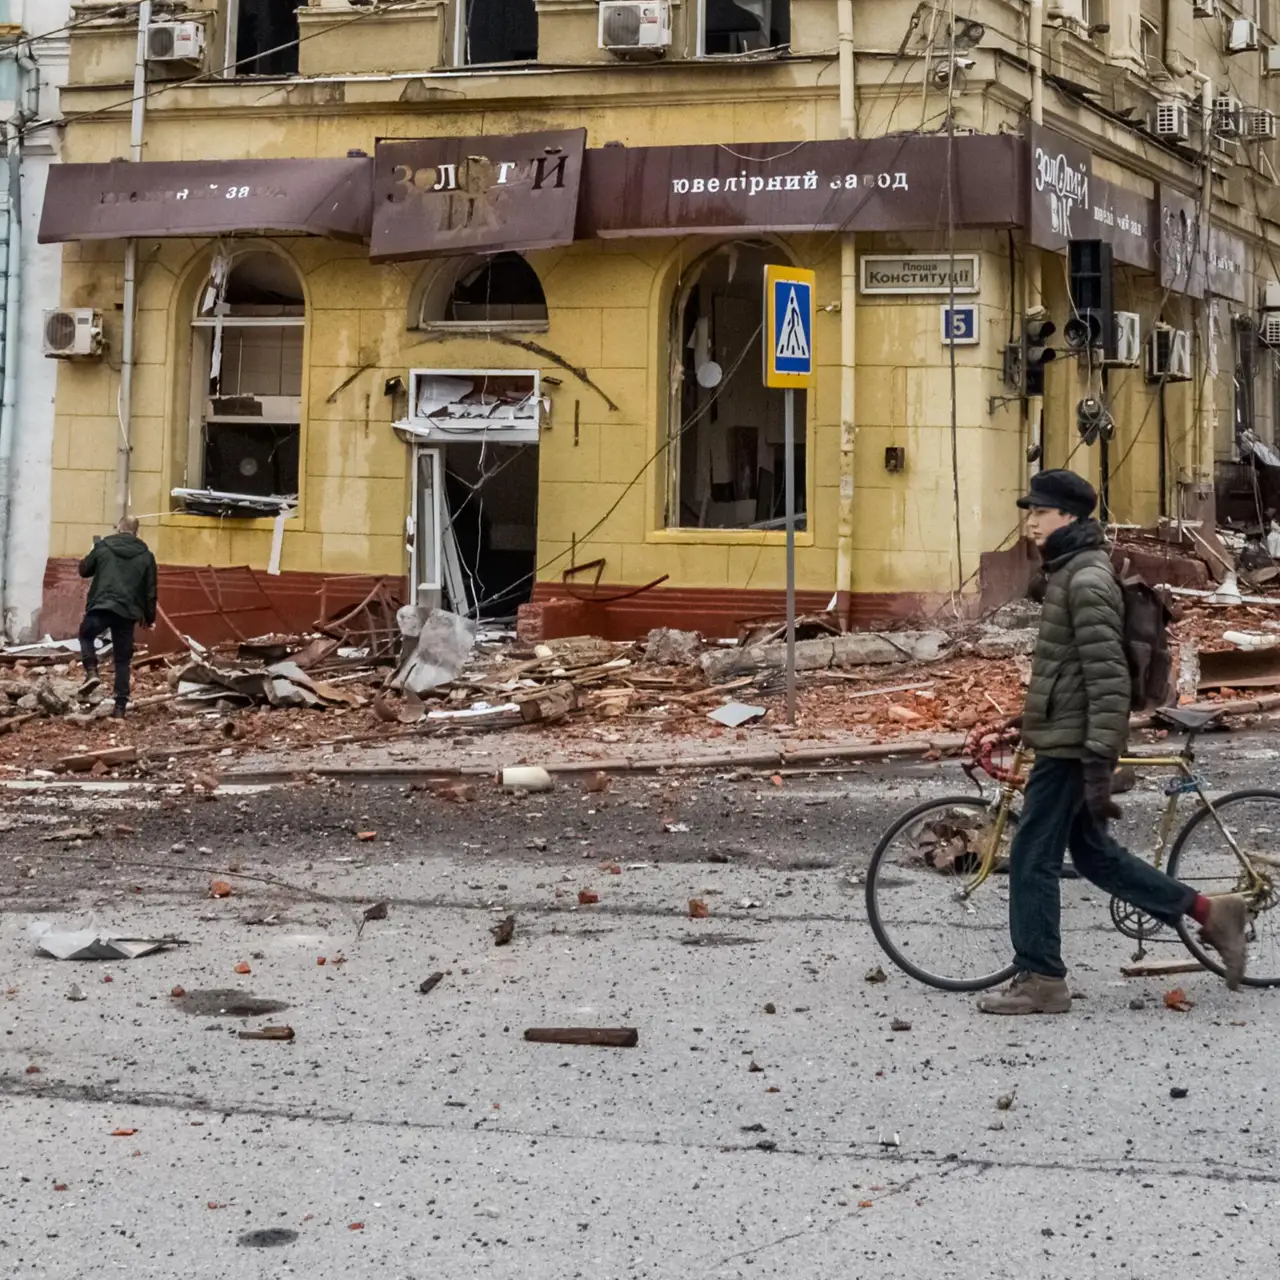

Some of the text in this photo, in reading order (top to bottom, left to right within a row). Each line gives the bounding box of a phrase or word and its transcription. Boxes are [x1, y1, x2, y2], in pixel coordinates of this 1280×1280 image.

[671, 170, 909, 196] ювелірний заод
[902, 262, 938, 273] Площа
[869, 269, 970, 286] Конституції
[951, 314, 967, 336] 5
